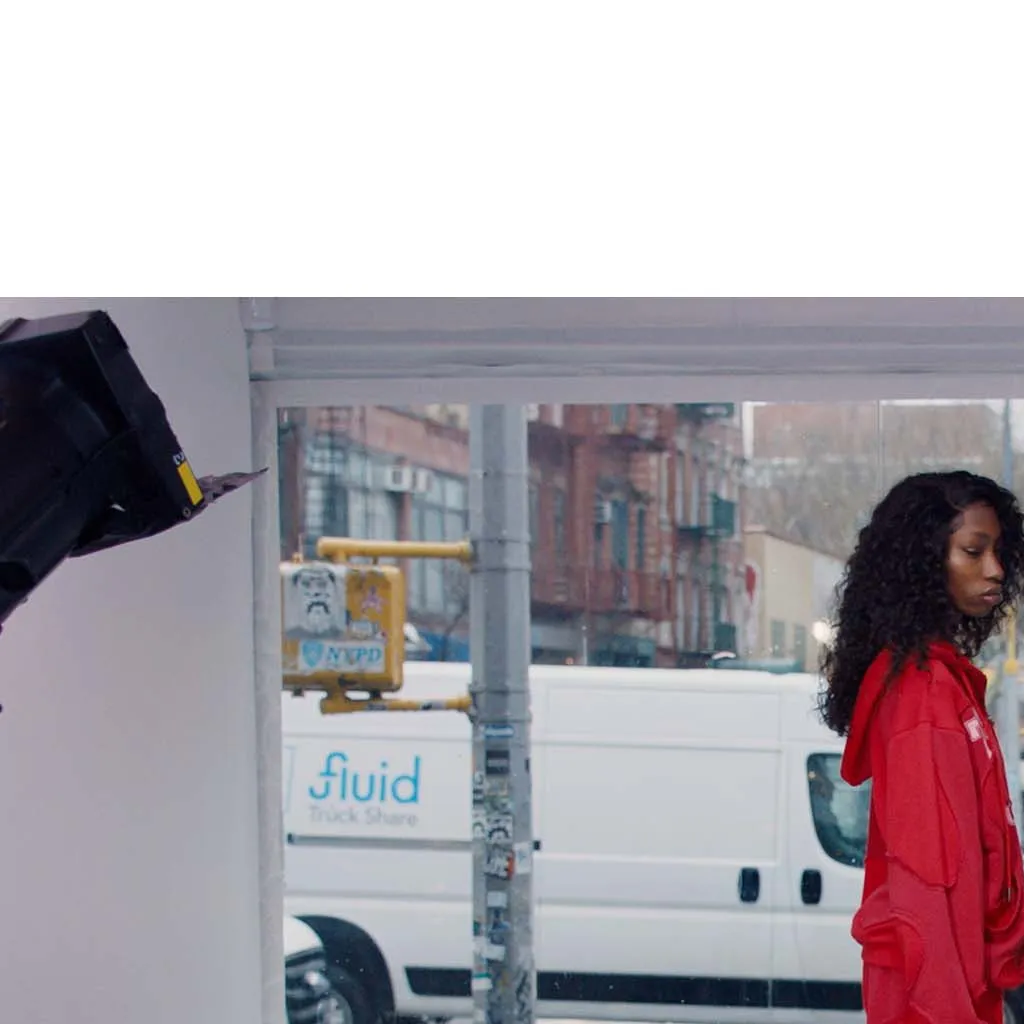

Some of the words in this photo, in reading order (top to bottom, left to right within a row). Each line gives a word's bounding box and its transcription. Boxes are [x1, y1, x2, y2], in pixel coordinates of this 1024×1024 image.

[327, 648, 383, 665] NYPD
[308, 751, 421, 804] fluid
[308, 804, 359, 823] Truck
[365, 806, 418, 827] Share
